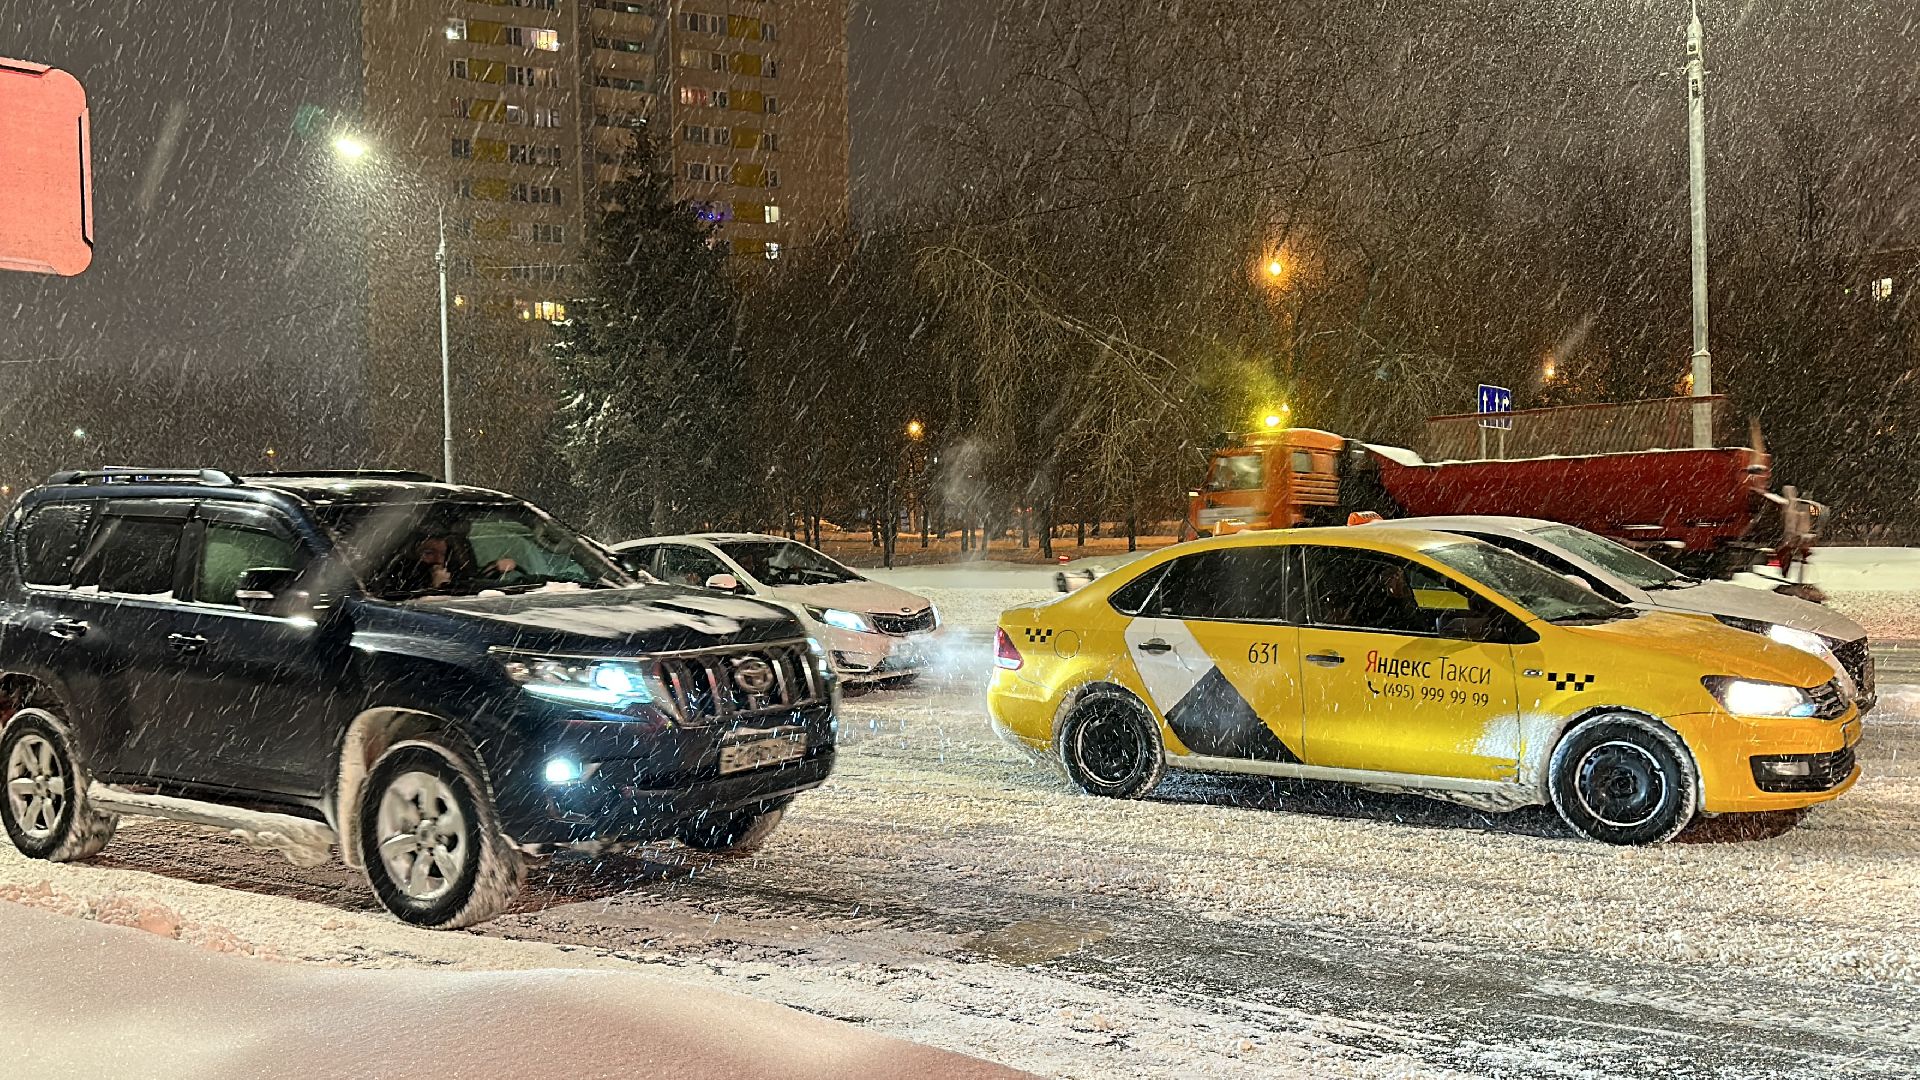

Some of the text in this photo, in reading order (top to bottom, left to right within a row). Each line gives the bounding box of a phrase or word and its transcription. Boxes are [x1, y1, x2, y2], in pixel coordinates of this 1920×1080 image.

[1248, 642, 1278, 664] 631
[1365, 650, 1490, 685] Яндекс Такси
[1383, 682, 1489, 706] (495) 999 99 99
